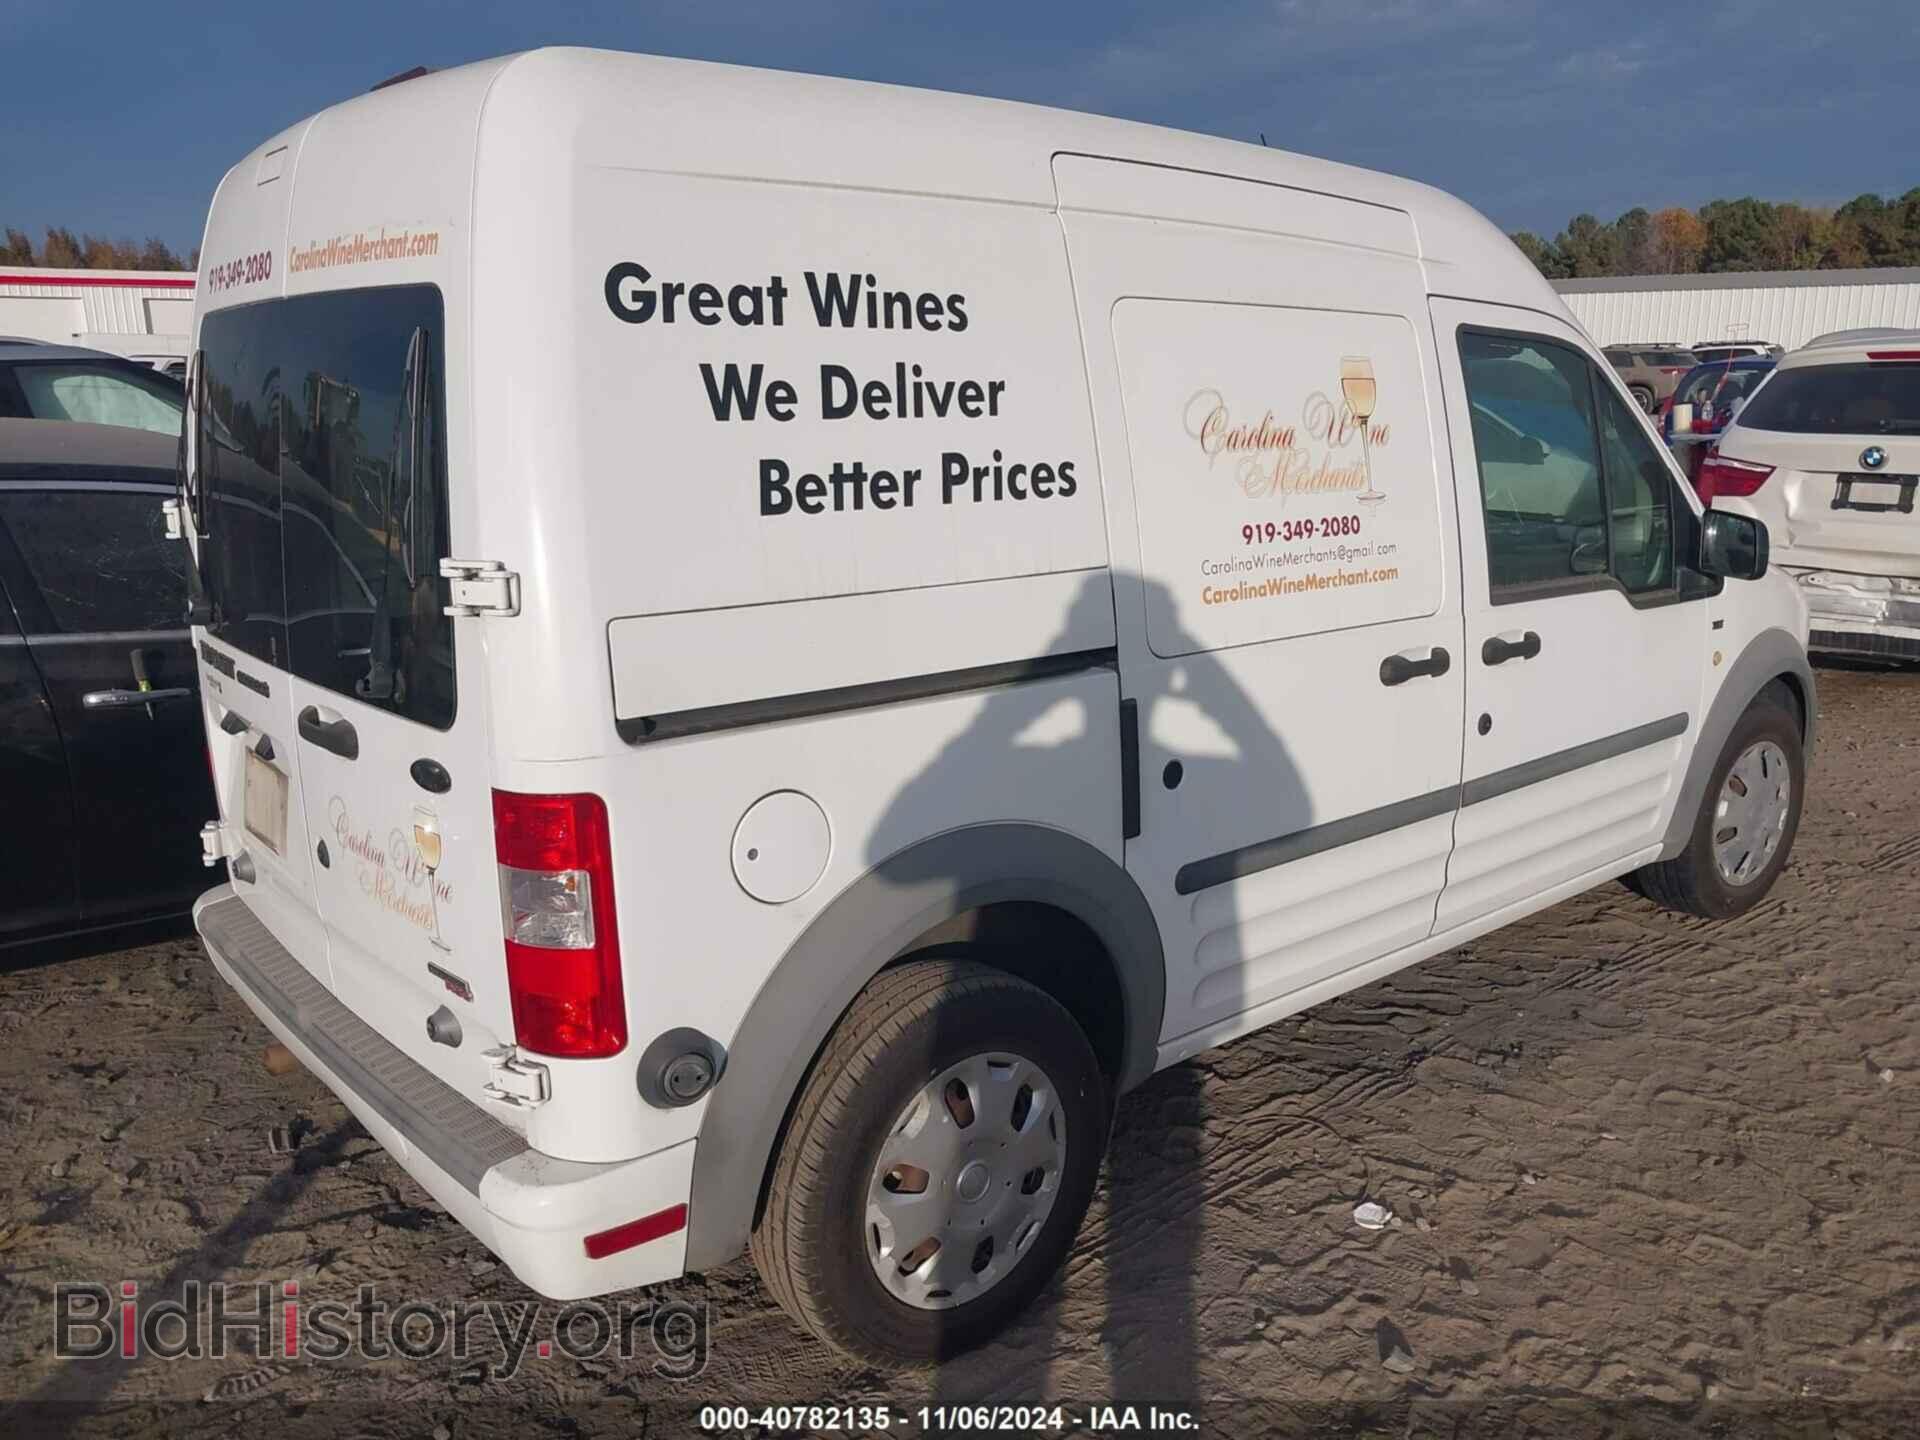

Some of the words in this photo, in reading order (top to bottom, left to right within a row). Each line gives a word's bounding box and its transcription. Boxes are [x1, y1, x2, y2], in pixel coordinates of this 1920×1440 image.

[208, 250, 272, 294] 919-349-2080
[289, 228, 438, 272] CarolinaWineMerchant.com
[604, 261, 788, 326] Great
[803, 271, 969, 332] Wines
[699, 363, 798, 422] We
[820, 362, 1005, 420] Deliver
[1183, 388, 1296, 471] Carolina
[1302, 391, 1391, 448] Wne
[759, 458, 922, 516] Better
[941, 449, 1077, 505] Prices
[1242, 515, 1361, 545] 919-349-2080
[1201, 541, 1397, 576] CarolinaWineMerchants@gmail.com
[1202, 567, 1399, 605] CarolinaWineMerchant.com
[389, 827, 454, 904] Wne
